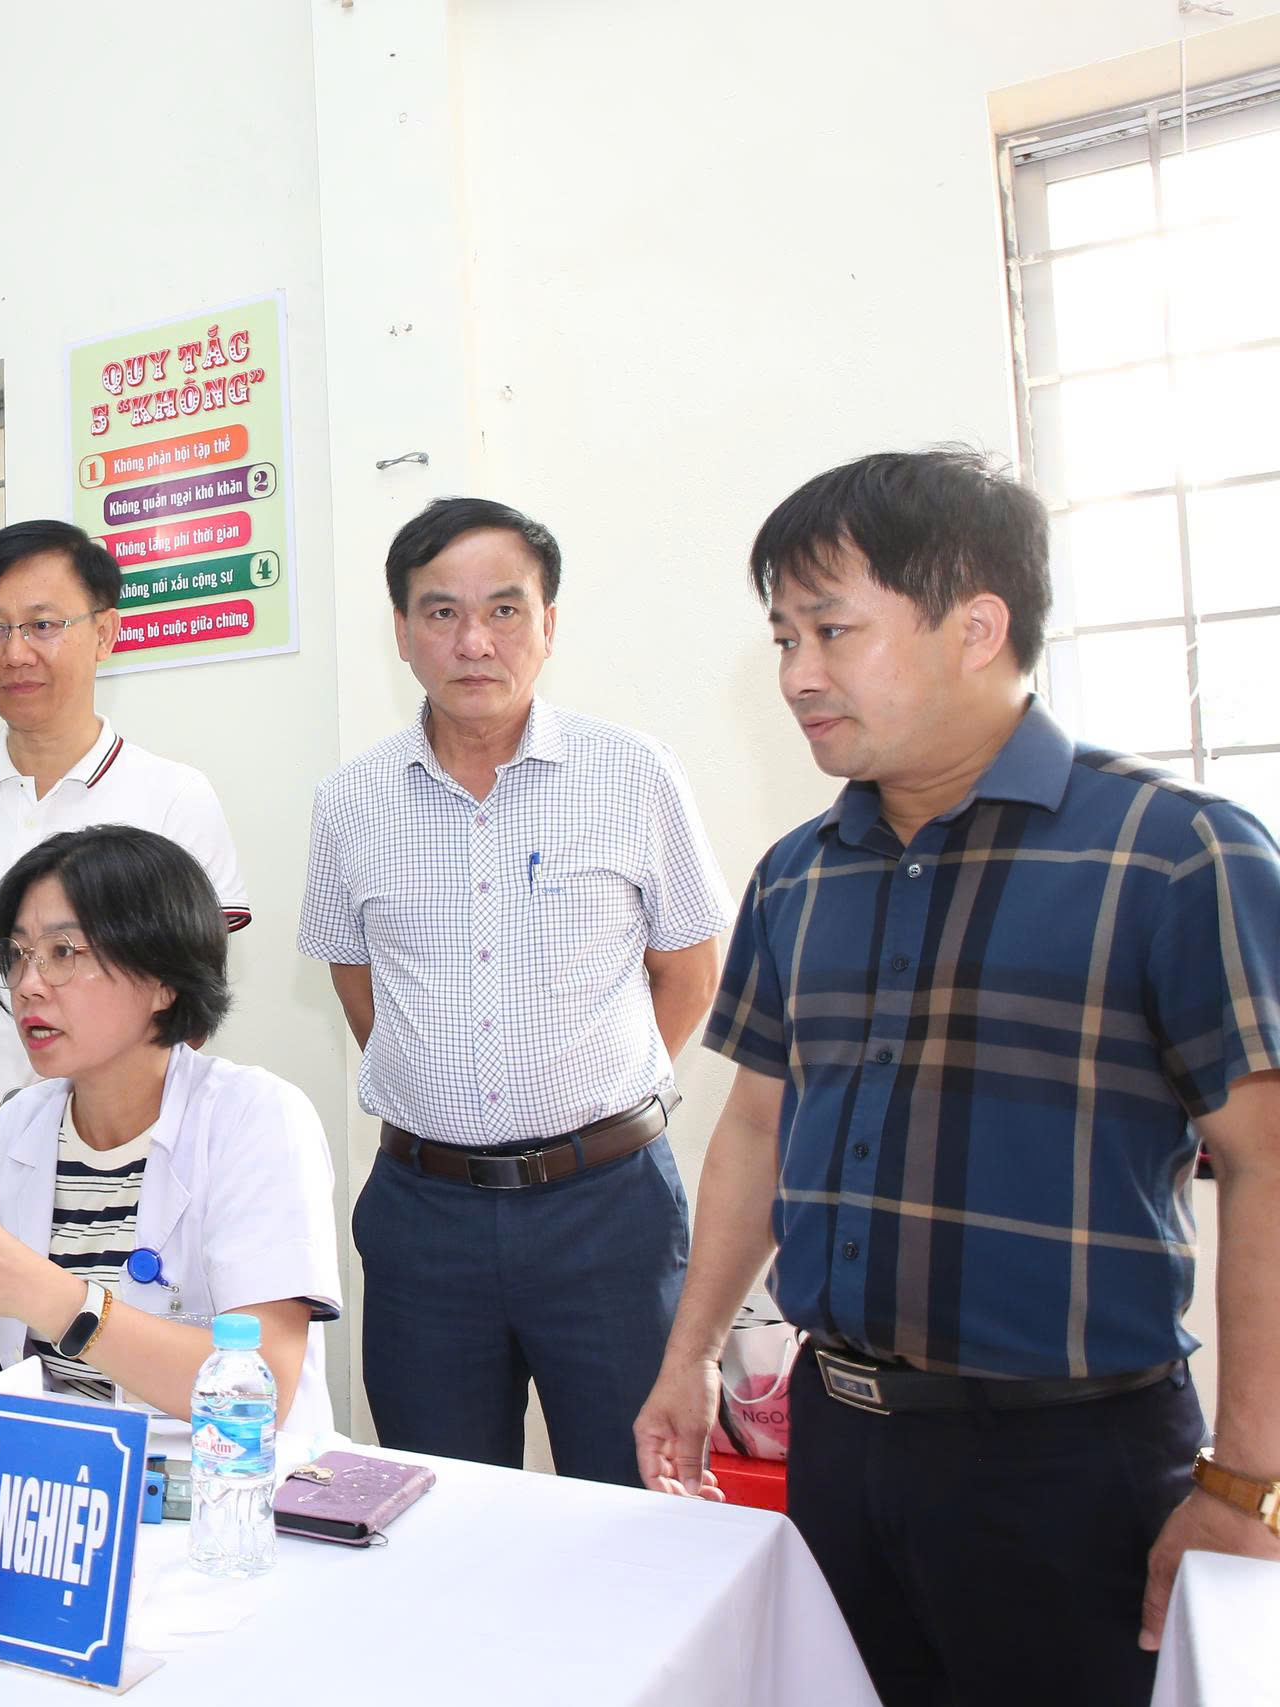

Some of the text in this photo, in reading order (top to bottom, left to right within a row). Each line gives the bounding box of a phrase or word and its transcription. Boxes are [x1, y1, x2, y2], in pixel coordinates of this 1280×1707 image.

[102, 324, 249, 395] QUY TẮC
[91, 404, 109, 435] 5
[87, 434, 231, 481] 1 Không phản bội tập thể
[109, 470, 269, 516] Không quản ngại khó khăn 2
[115, 539, 147, 557] Không
[174, 531, 190, 550] phí
[193, 526, 213, 544] thời
[216, 524, 239, 543] gian
[153, 578, 168, 594] nói
[171, 574, 189, 591] xấu
[192, 572, 218, 590] cộng
[220, 569, 234, 585] sự
[255, 558, 272, 580] 4
[147, 622, 160, 638] bỏ
[163, 620, 187, 637] cuộc
[190, 616, 213, 635] giữa
[216, 612, 249, 628] chừng
[742, 1410, 791, 1424] NGO
